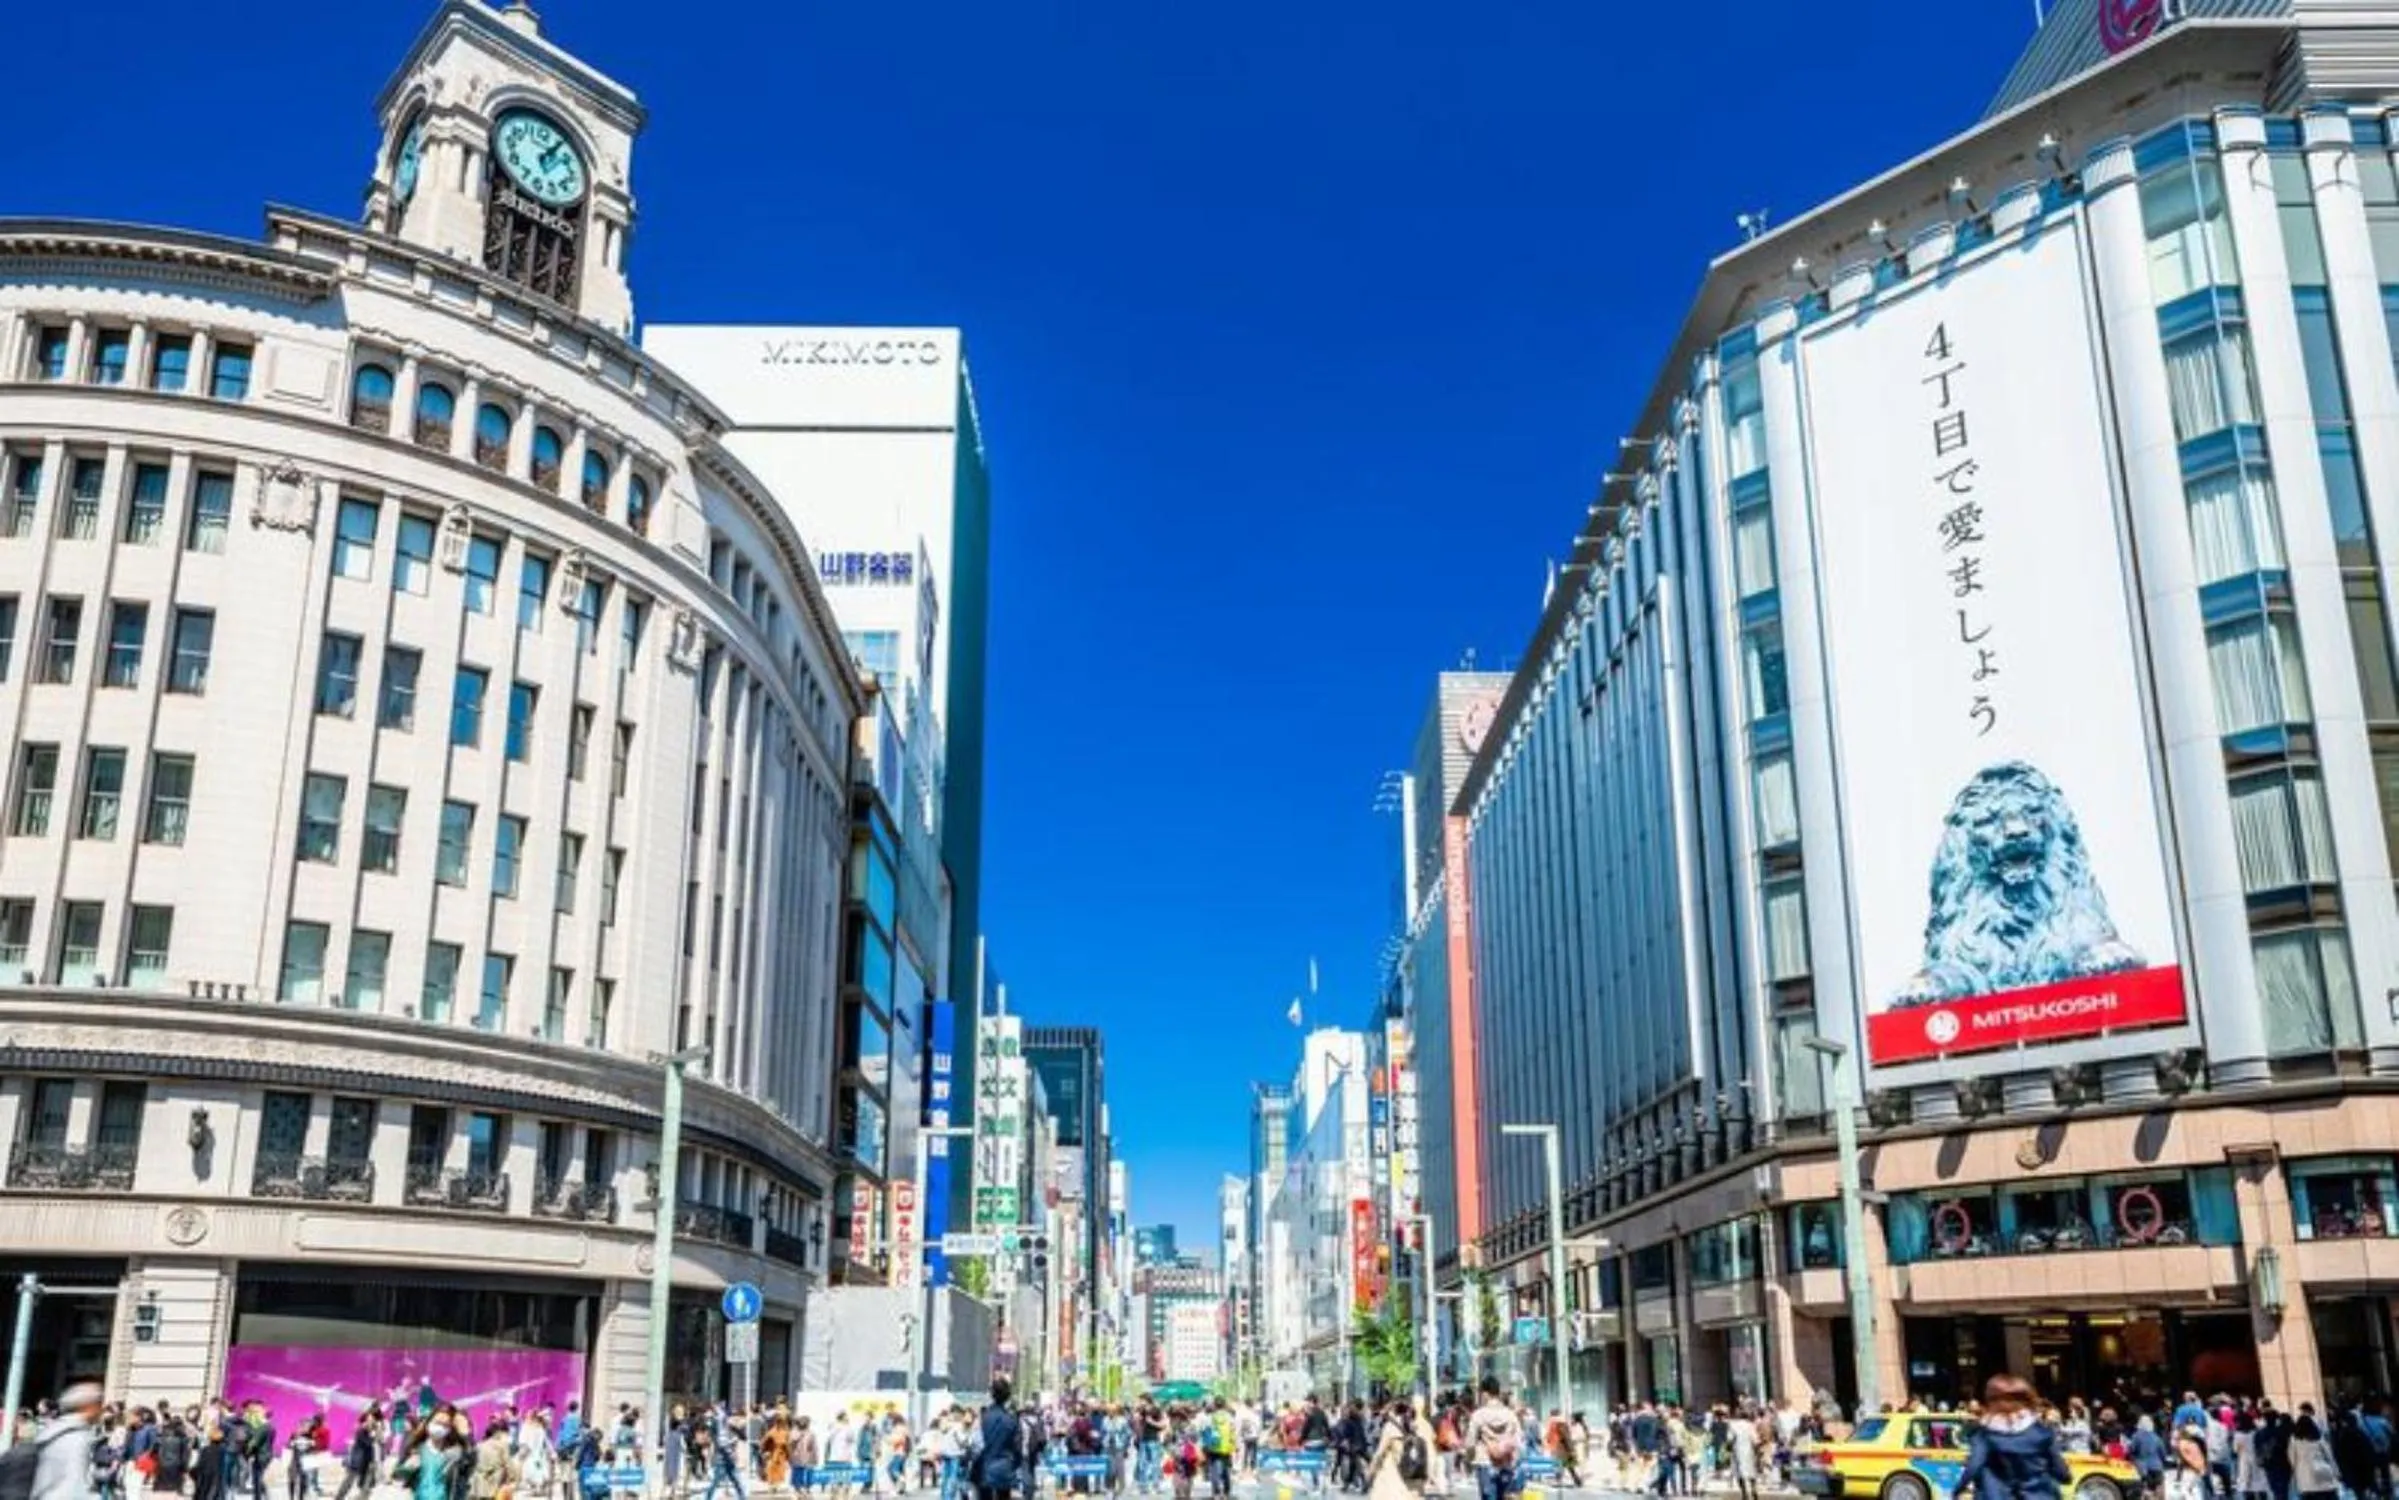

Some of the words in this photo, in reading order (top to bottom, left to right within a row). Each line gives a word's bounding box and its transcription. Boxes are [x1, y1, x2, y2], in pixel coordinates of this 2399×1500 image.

[1921, 320, 2000, 737] 4丁目で愛ましょう
[1972, 990, 2118, 1030] MITSUKOSHI
